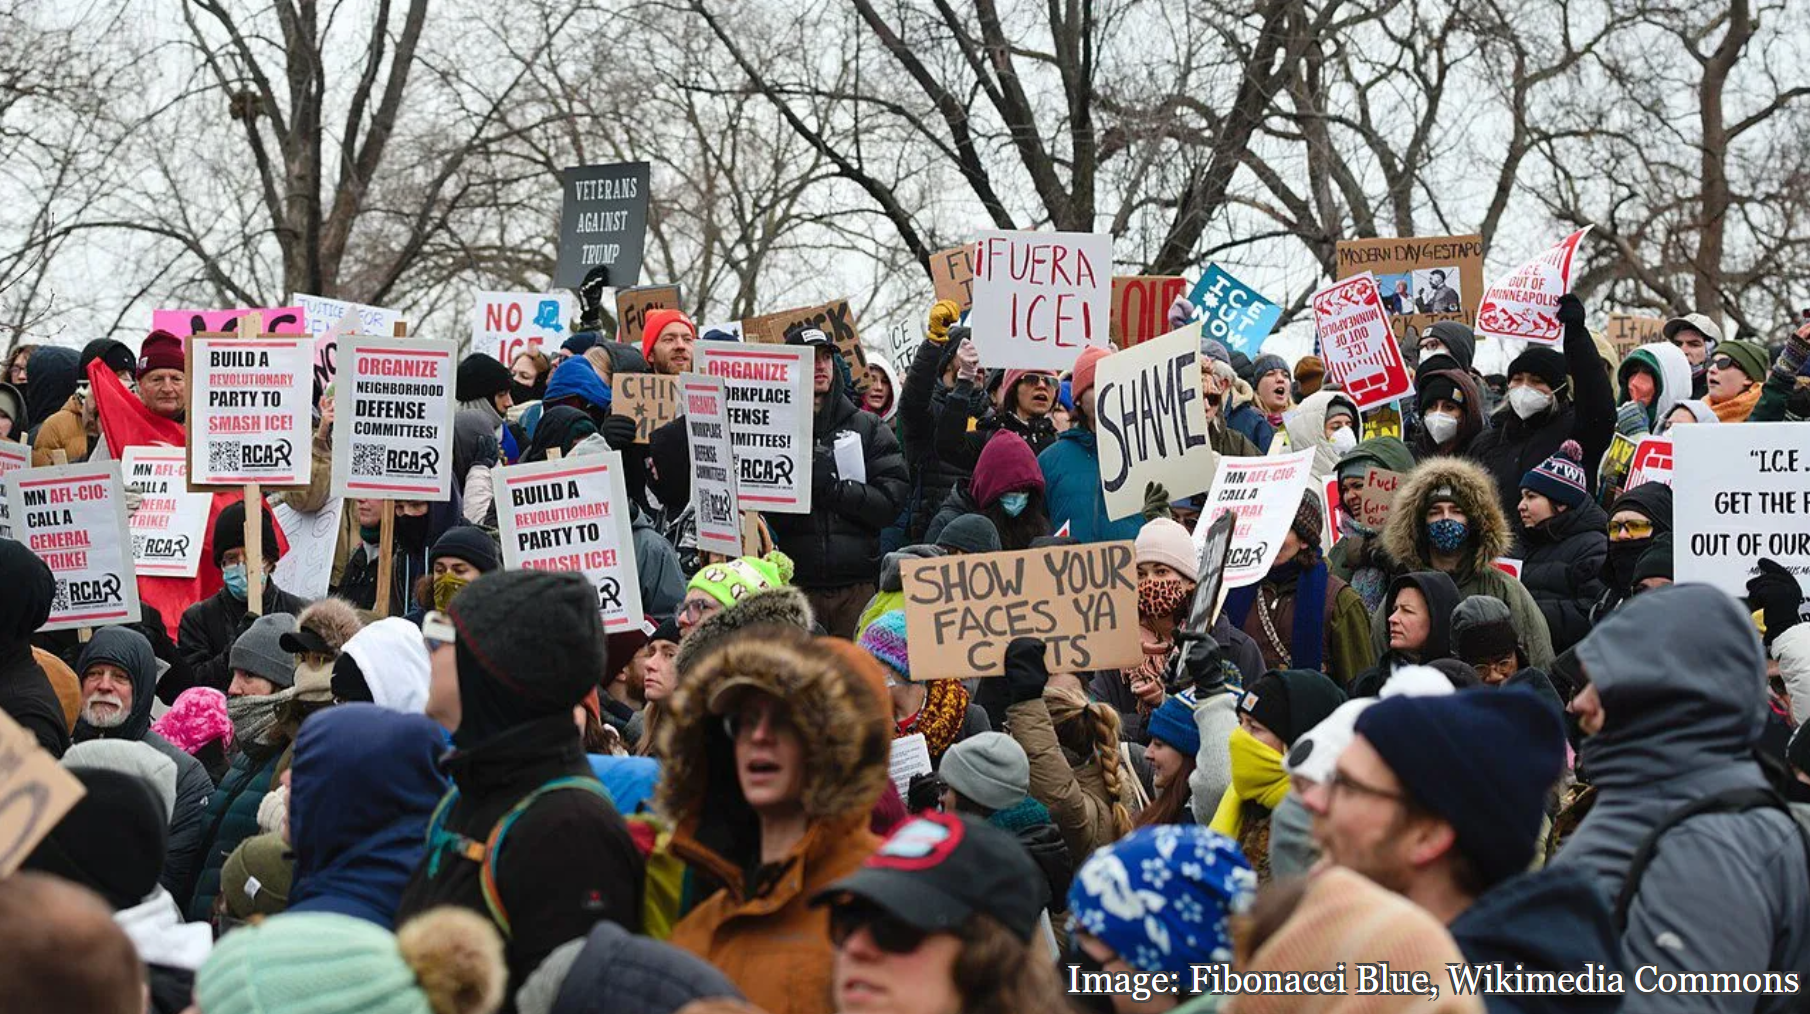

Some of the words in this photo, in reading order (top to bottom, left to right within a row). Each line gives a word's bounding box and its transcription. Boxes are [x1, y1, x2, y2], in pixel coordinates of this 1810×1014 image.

[575, 177, 637, 200] VETERANS
[576, 211, 628, 233] AGAINST
[582, 243, 620, 265] TRUMP
[1340, 248, 1391, 267] MODERN
[1395, 243, 1421, 264] DAY
[1422, 242, 1482, 262] GESTAPO
[1508, 276, 1530, 289] OUT
[1532, 277, 1546, 291] OF
[1209, 275, 1267, 320] ICE
[1489, 288, 1560, 308] MINNEAPOLIS
[486, 302, 523, 333] NO
[1011, 293, 1092, 349] ICE!
[1191, 304, 1249, 349] NOW
[1321, 308, 1379, 339] MINNEAPOLIS
[888, 319, 912, 354] ICE
[1335, 332, 1348, 348] OF
[1349, 326, 1370, 344] OUT
[210, 351, 255, 367] BUILD
[258, 351, 270, 367] A
[358, 357, 438, 378] ORGANIZE
[209, 373, 293, 387] REVOLUTIONARY
[708, 360, 788, 382] ORGANIZE
[356, 381, 444, 396] NEIGHBORHOOD
[724, 385, 791, 404] ORKPLACE
[209, 391, 258, 407] PARTY
[261, 391, 282, 407] TO
[688, 395, 718, 415] ORGANIZE
[355, 400, 426, 419] DEFENSE
[728, 407, 770, 426] FENSE
[208, 415, 261, 432] SMASH
[265, 415, 293, 431] ICE!
[354, 421, 438, 439] COMMITTEES!
[690, 421, 722, 439] WORKPLACE
[1097, 351, 1206, 493] SHAME
[242, 445, 274, 463] RCA
[386, 449, 421, 470] RCA
[694, 444, 717, 463] DEFENSE
[133, 464, 153, 476] MN
[696, 464, 727, 482] COMMITTEES!
[740, 459, 774, 480] RCA
[1224, 471, 1247, 485] MN
[1246, 466, 1297, 483] AFL-CIO:
[23, 488, 47, 506] MN
[50, 484, 109, 504] AFL-CIO:
[159, 481, 168, 493] A
[511, 482, 564, 507] BUILD
[568, 480, 580, 499] A
[1218, 488, 1245, 502] CALL
[1248, 487, 1259, 500] A
[710, 494, 726, 519] RCA
[1714, 491, 1752, 514] GET
[1758, 491, 1797, 514] THE
[27, 510, 61, 528] CALL
[63, 509, 73, 525] A
[130, 514, 170, 529] TRIKE!
[514, 501, 610, 527] REVOLUTIONARY
[30, 530, 91, 550] GENERAL
[145, 538, 174, 554] RCA
[518, 526, 573, 551] PARTY
[576, 522, 600, 543] TO
[1691, 533, 1731, 556] OUT
[1737, 533, 1762, 556] OF
[1768, 533, 1810, 556] OUR
[37, 550, 88, 570] TRIKE!
[584, 549, 618, 571] ICE!
[909, 557, 1025, 605] SHOW
[1043, 544, 1136, 596] YOUR
[69, 578, 103, 602] RCA
[934, 599, 1058, 645] FACES
[1072, 591, 1117, 634] YA
[967, 633, 1092, 672] CTS
